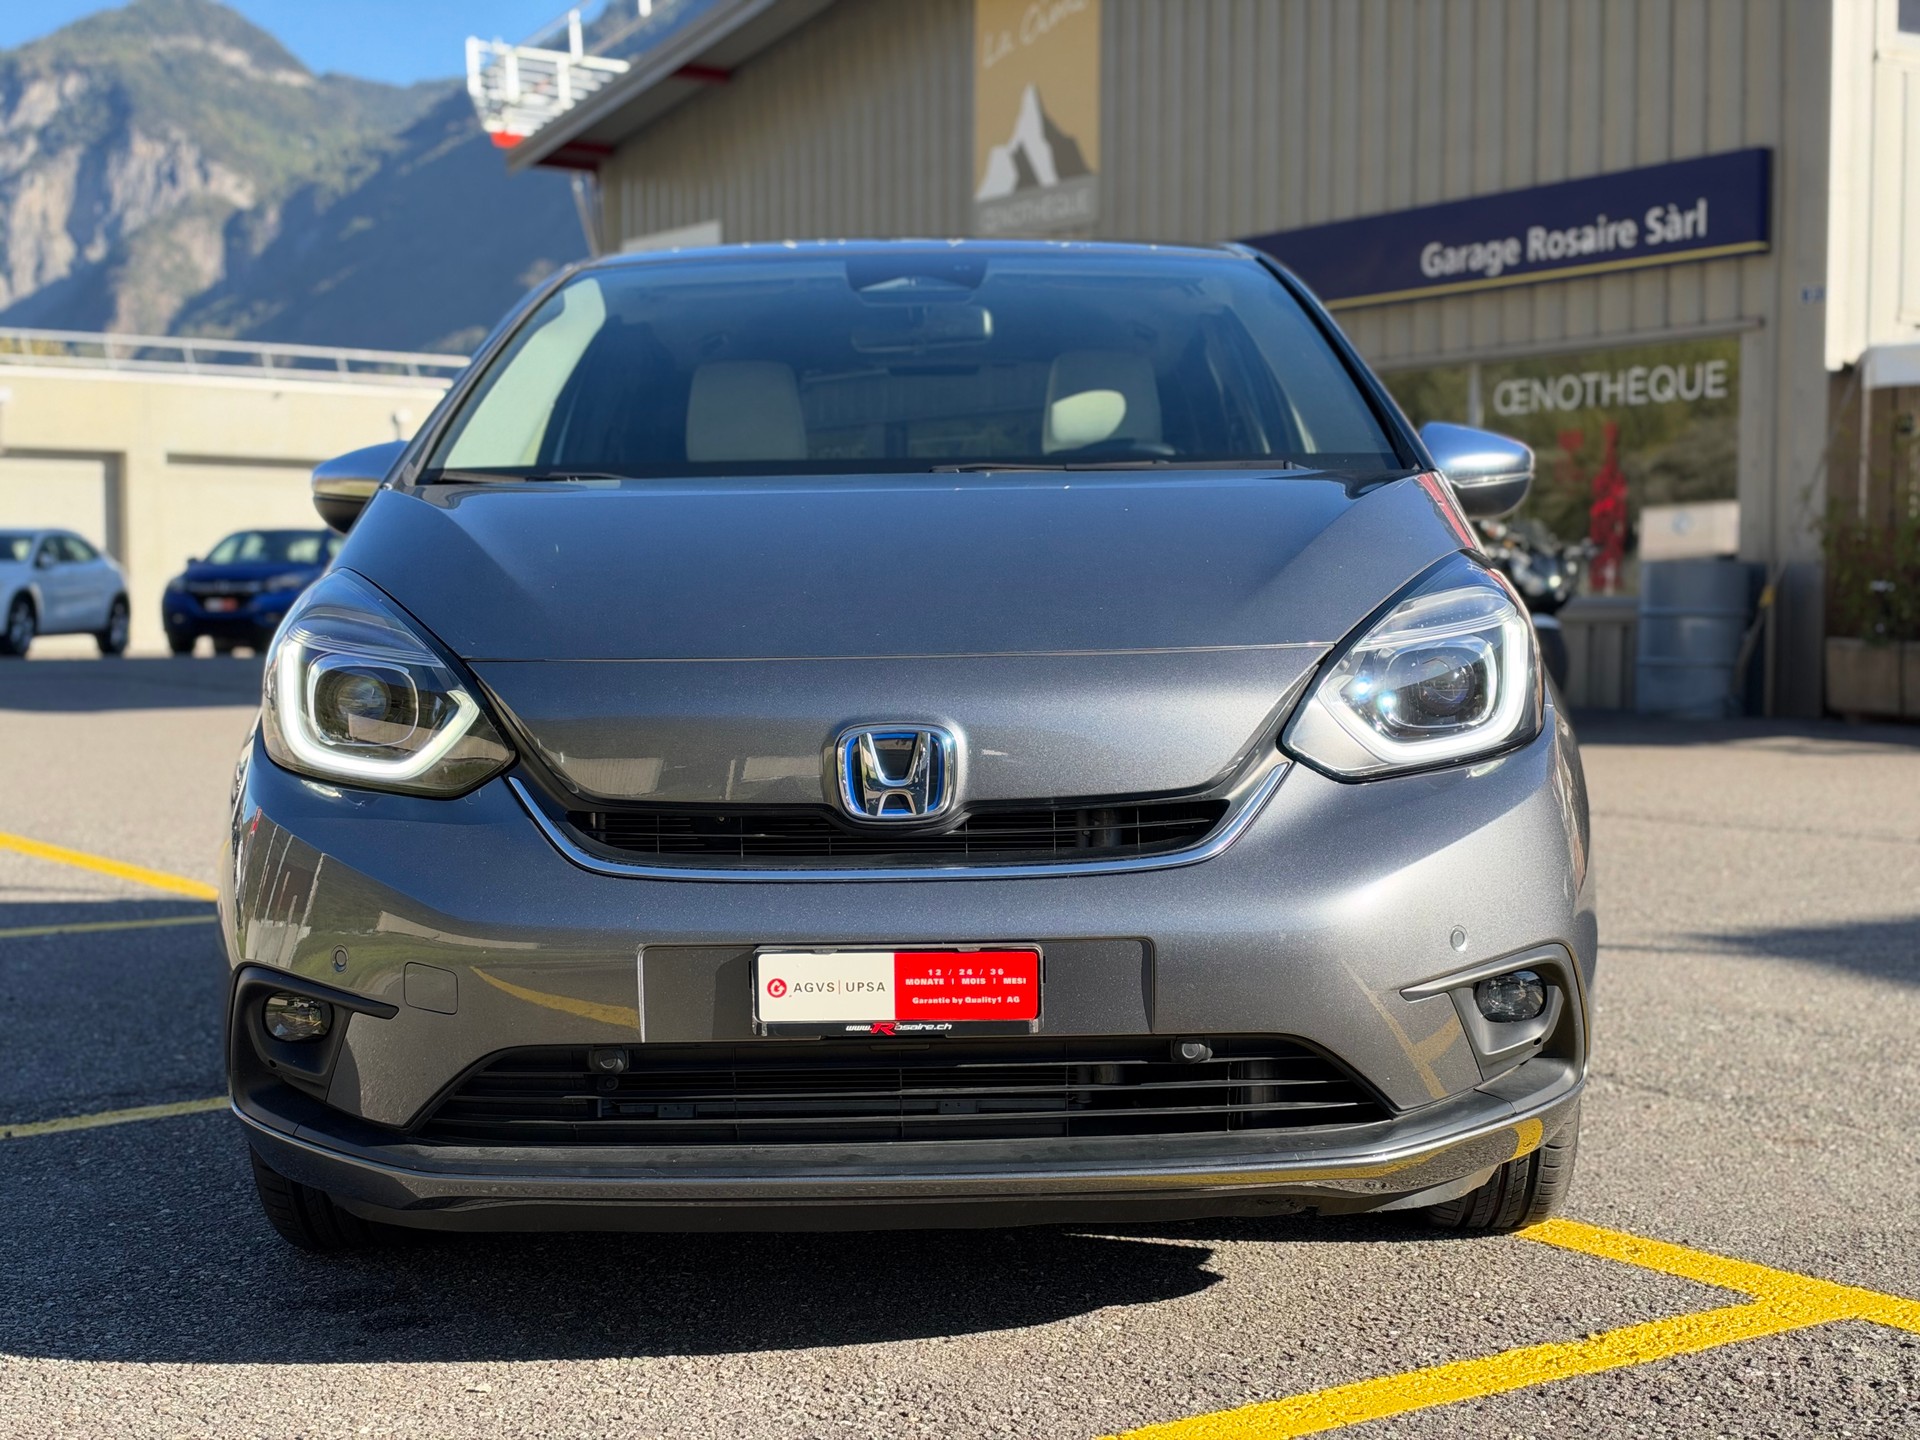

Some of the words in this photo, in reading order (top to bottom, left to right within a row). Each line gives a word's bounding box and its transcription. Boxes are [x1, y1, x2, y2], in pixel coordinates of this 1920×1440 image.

[1420, 236, 1521, 278] Garage
[1526, 213, 1639, 263] Rosaire
[1645, 197, 1708, 245] Sàrl
[793, 982, 835, 993] AGVS
[845, 981, 886, 992] UPSA
[912, 996, 950, 1004] Garantie
[952, 996, 963, 1005] by
[964, 996, 1002, 1004] Quality1
